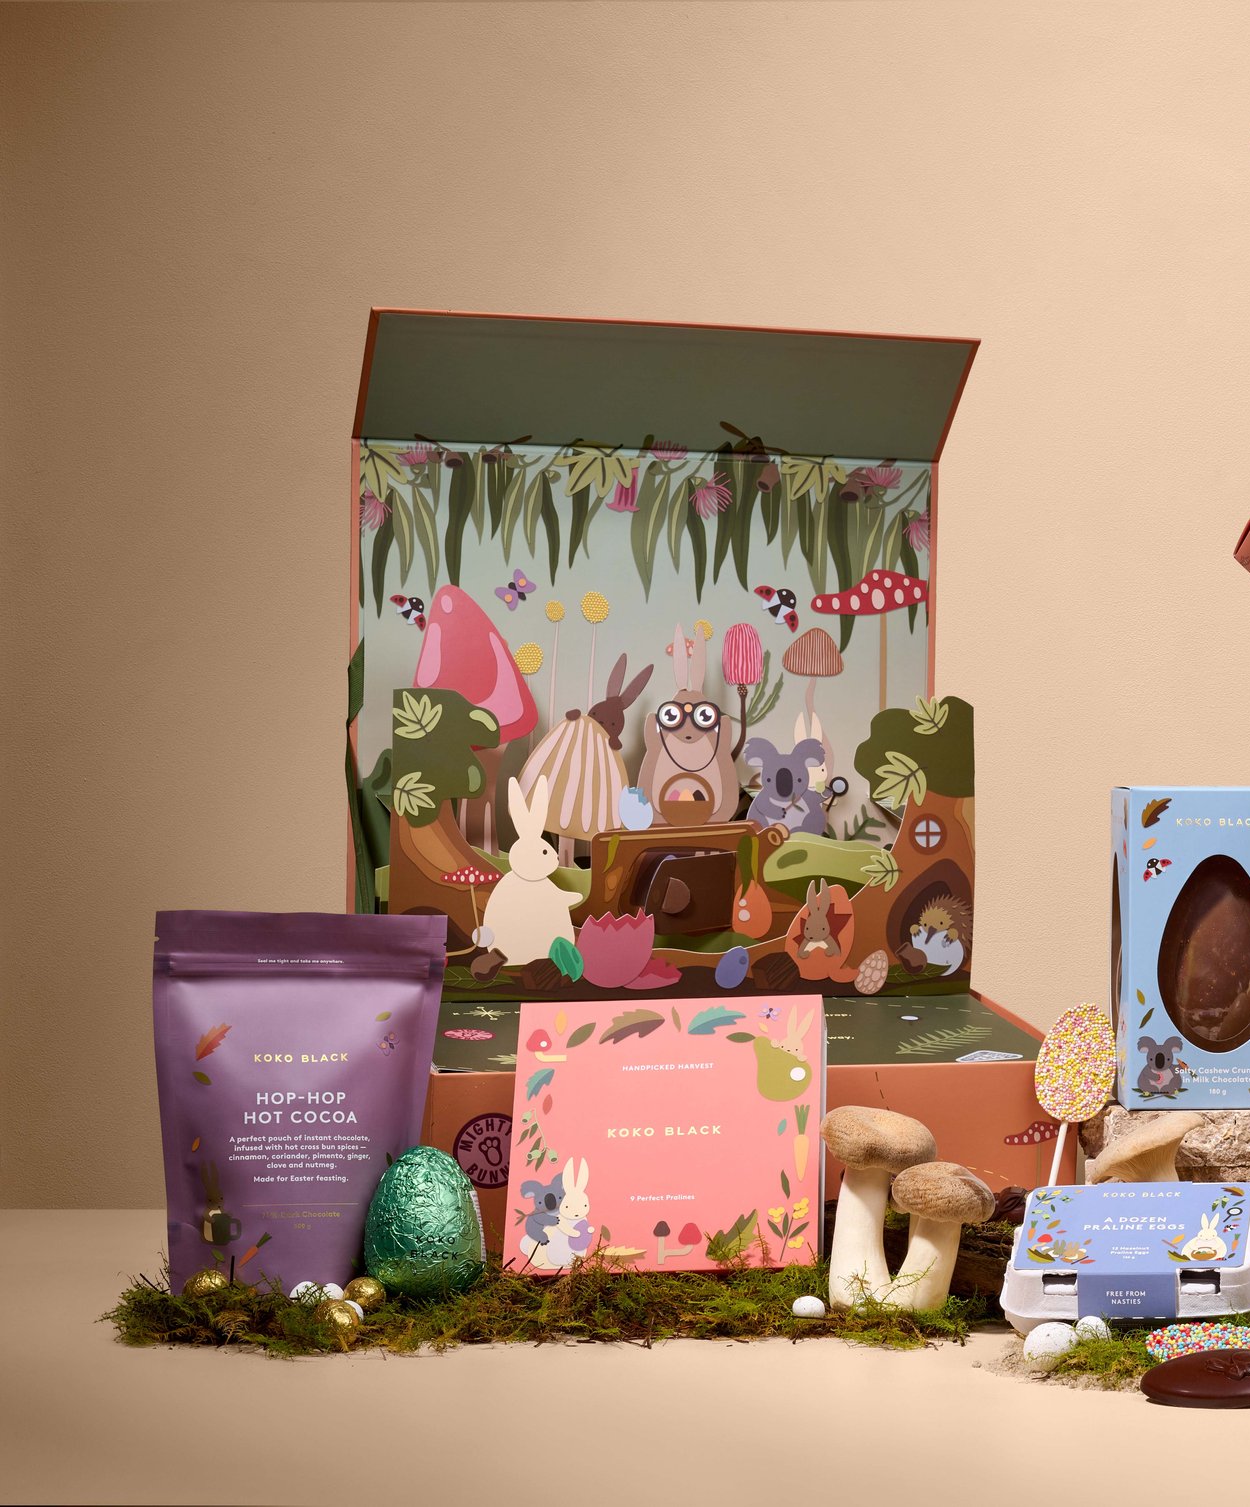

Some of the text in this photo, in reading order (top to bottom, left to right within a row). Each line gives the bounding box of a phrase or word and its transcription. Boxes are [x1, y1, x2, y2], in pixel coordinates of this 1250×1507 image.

[1176, 818, 1211, 827] KOKO
[254, 1052, 348, 1063] KOKO BLACK
[1174, 1066, 1196, 1076] Salty
[1192, 1076, 1210, 1084] Milk
[256, 1092, 346, 1105] HOP-HOP
[244, 1110, 358, 1124] HOT COCOA
[459, 1118, 512, 1152] MIGHTY
[608, 1125, 721, 1138] KOKO BLACK
[236, 1135, 266, 1144] perfect
[268, 1134, 292, 1143] pouch
[312, 1152, 346, 1160] pimento,
[347, 1152, 370, 1160] ginger,
[466, 1161, 510, 1184] BUNN
[316, 1174, 348, 1183] feasting.
[410, 1236, 458, 1260] KOKO BLACK
